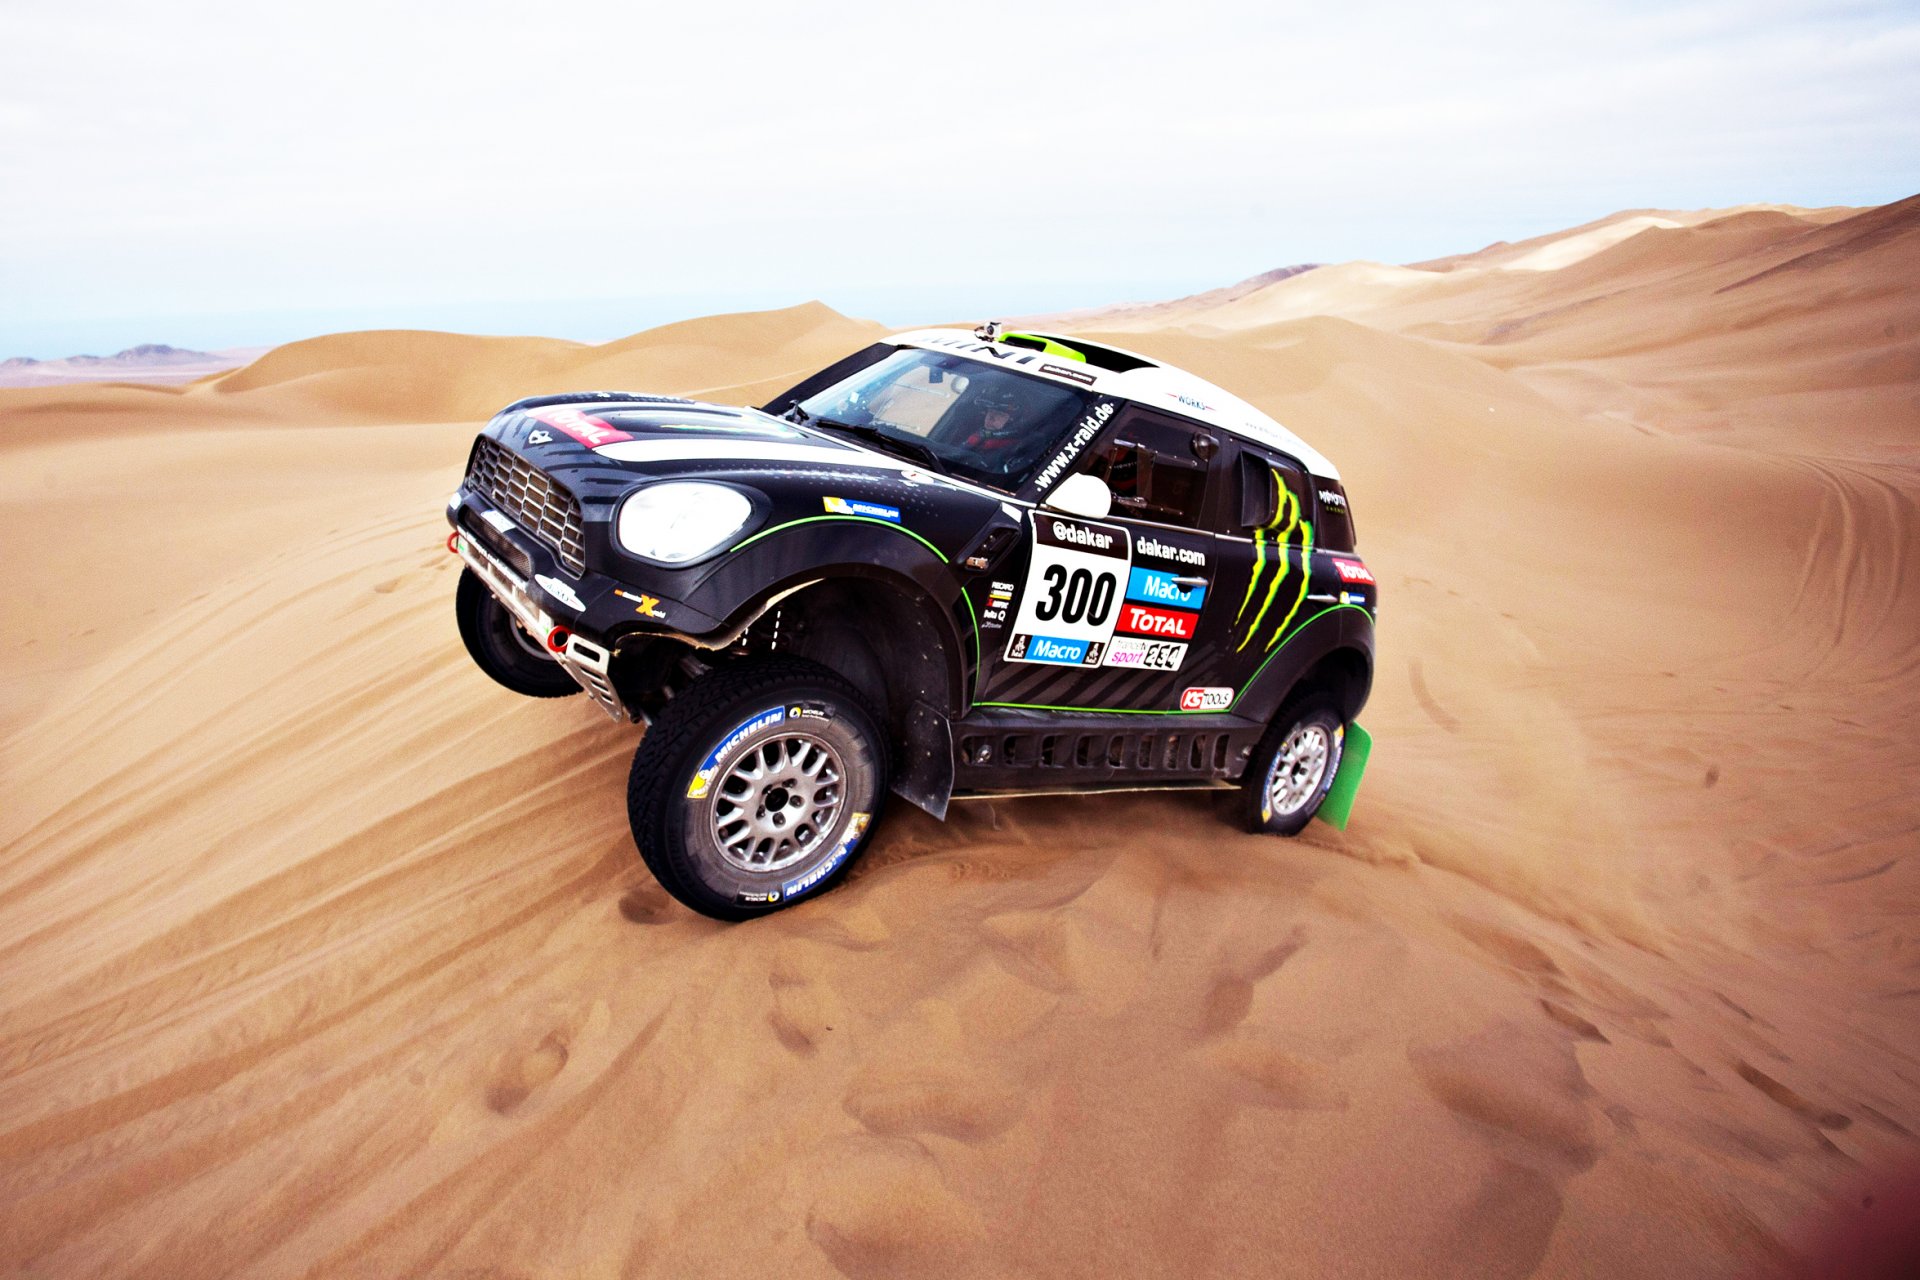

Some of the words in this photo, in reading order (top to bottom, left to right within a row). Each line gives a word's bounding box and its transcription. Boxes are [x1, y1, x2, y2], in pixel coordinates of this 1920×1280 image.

[1052, 520, 1113, 550] @dakar
[1136, 536, 1206, 566] dakar.com
[1334, 561, 1374, 581] TOTAL
[1035, 563, 1117, 626] 300
[1130, 607, 1187, 635] TOTAL
[1033, 639, 1081, 660] Macro
[1111, 651, 1143, 665] sport
[714, 711, 783, 763] MICHELIN
